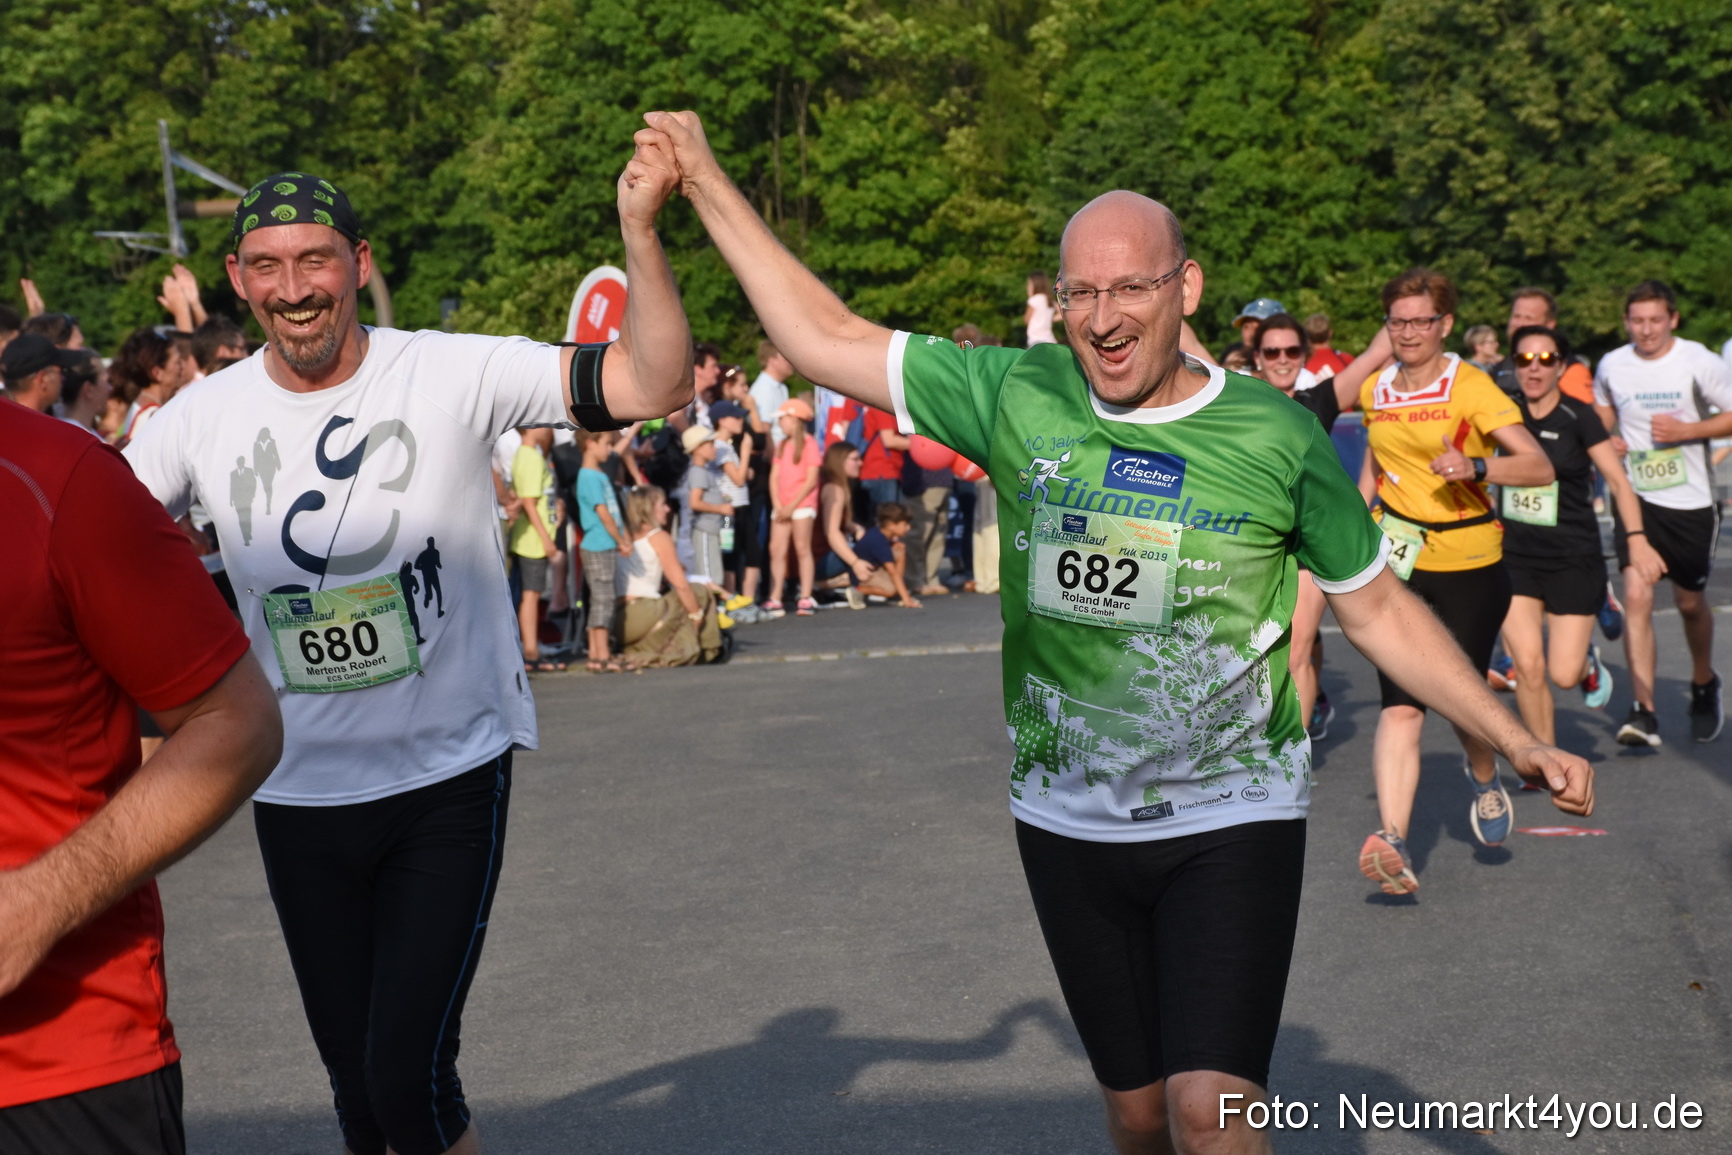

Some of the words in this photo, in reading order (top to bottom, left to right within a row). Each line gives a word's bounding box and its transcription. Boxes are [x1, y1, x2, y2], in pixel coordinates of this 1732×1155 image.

[1408, 407, 1452, 423] BÖGL
[1024, 435, 1044, 452] 10
[1050, 434, 1087, 452] Jahe
[1123, 465, 1179, 483] Fischer
[1637, 460, 1678, 479] 1008
[1126, 476, 1173, 488] AUTOMOBILE
[1061, 477, 1253, 535] firmenlauf
[1512, 492, 1542, 512] 945
[1050, 527, 1108, 546] firmenlauf
[1118, 546, 1136, 557] run
[1139, 549, 1168, 562] 2019
[1057, 550, 1140, 599] 682
[1174, 576, 1231, 607] ger!
[371, 602, 396, 616] 2019
[1062, 591, 1100, 606] Roland
[1102, 598, 1131, 611] Marc
[284, 609, 336, 623] firmenlauf
[1073, 604, 1089, 614] ECS
[1091, 606, 1115, 618] GmbH
[299, 620, 379, 665] 680
[306, 664, 347, 676] Mertens
[349, 655, 387, 672] Robert
[327, 673, 343, 683] ECS
[344, 670, 368, 681] GmbH
[1137, 806, 1159, 817] AOK
[1178, 796, 1222, 811] Frischmann
